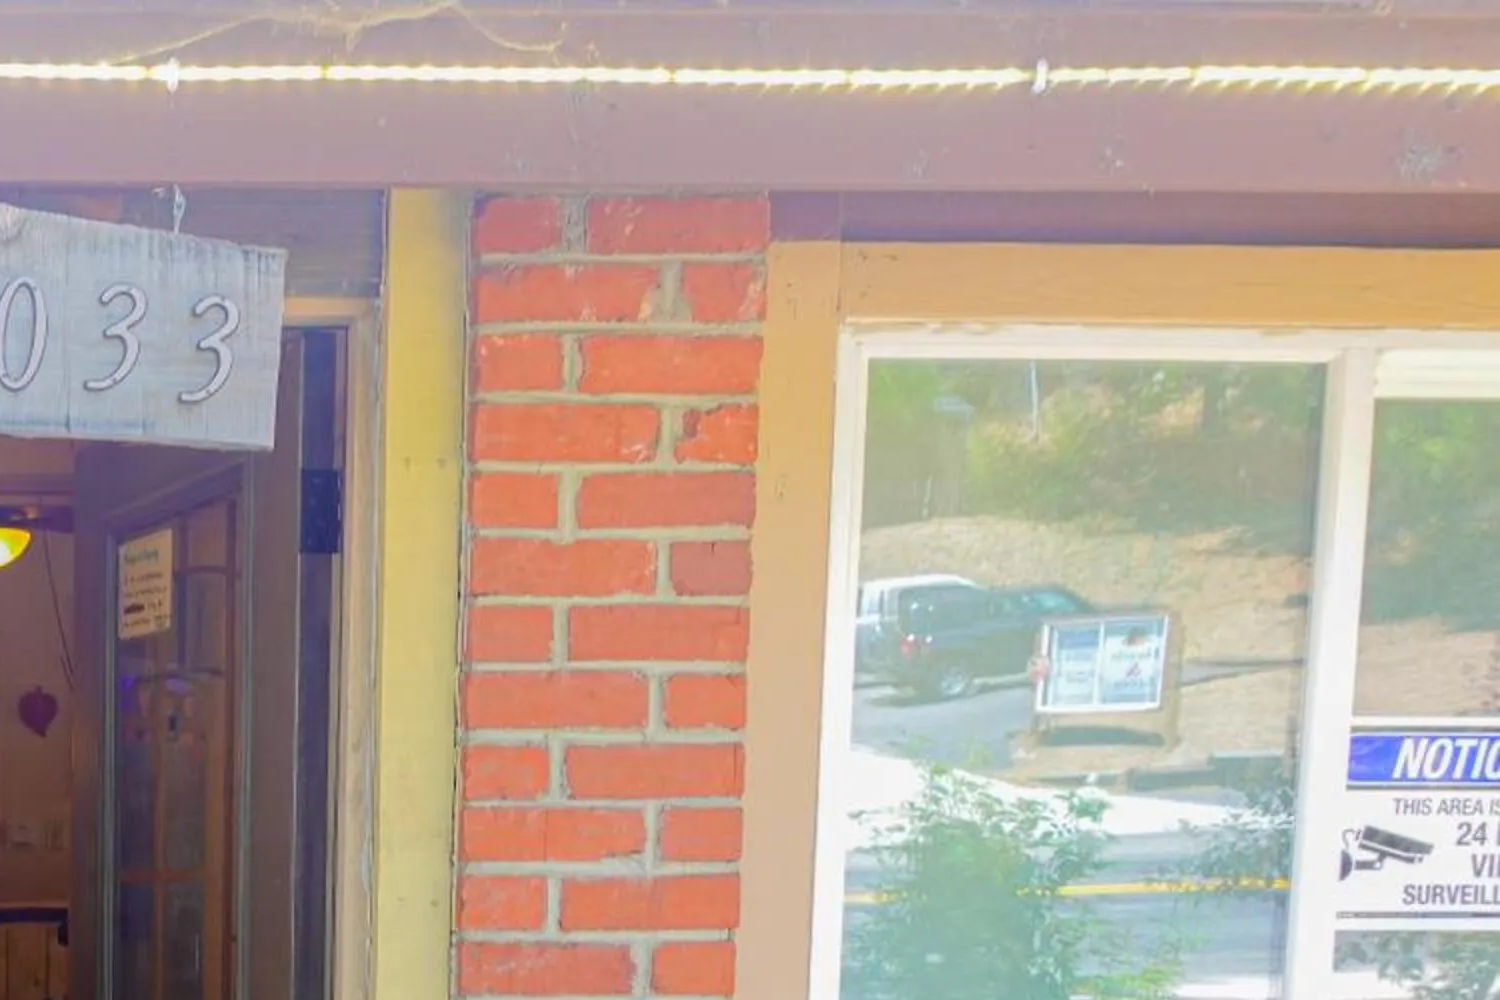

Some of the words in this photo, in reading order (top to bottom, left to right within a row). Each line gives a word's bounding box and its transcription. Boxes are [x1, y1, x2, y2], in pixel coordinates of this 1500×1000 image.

[1393, 798, 1432, 815] THIS
[1436, 798, 1483, 815] AREA
[1456, 821, 1488, 846] 24
[1471, 853, 1500, 878] VI
